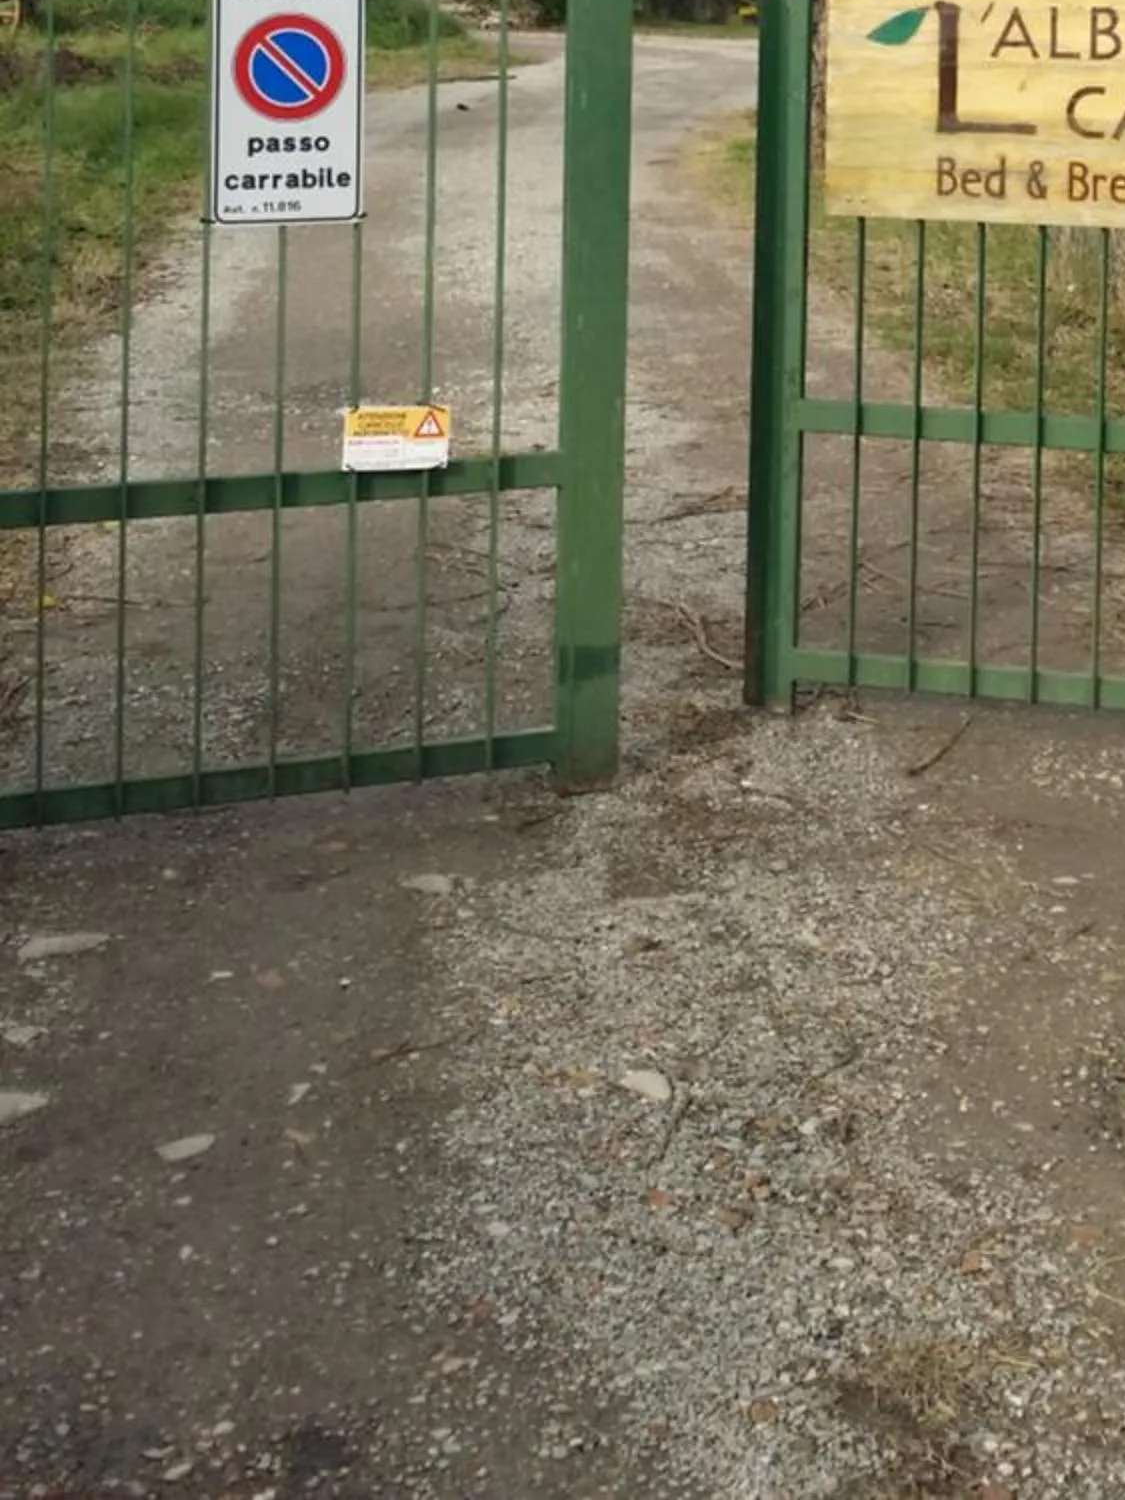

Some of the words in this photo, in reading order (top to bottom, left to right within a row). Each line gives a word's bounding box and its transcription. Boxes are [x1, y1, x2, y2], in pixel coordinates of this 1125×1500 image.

[248, 136, 330, 157] passo
[224, 167, 352, 190] carrabile
[936, 156, 1007, 198] Bed
[1026, 160, 1048, 200] &
